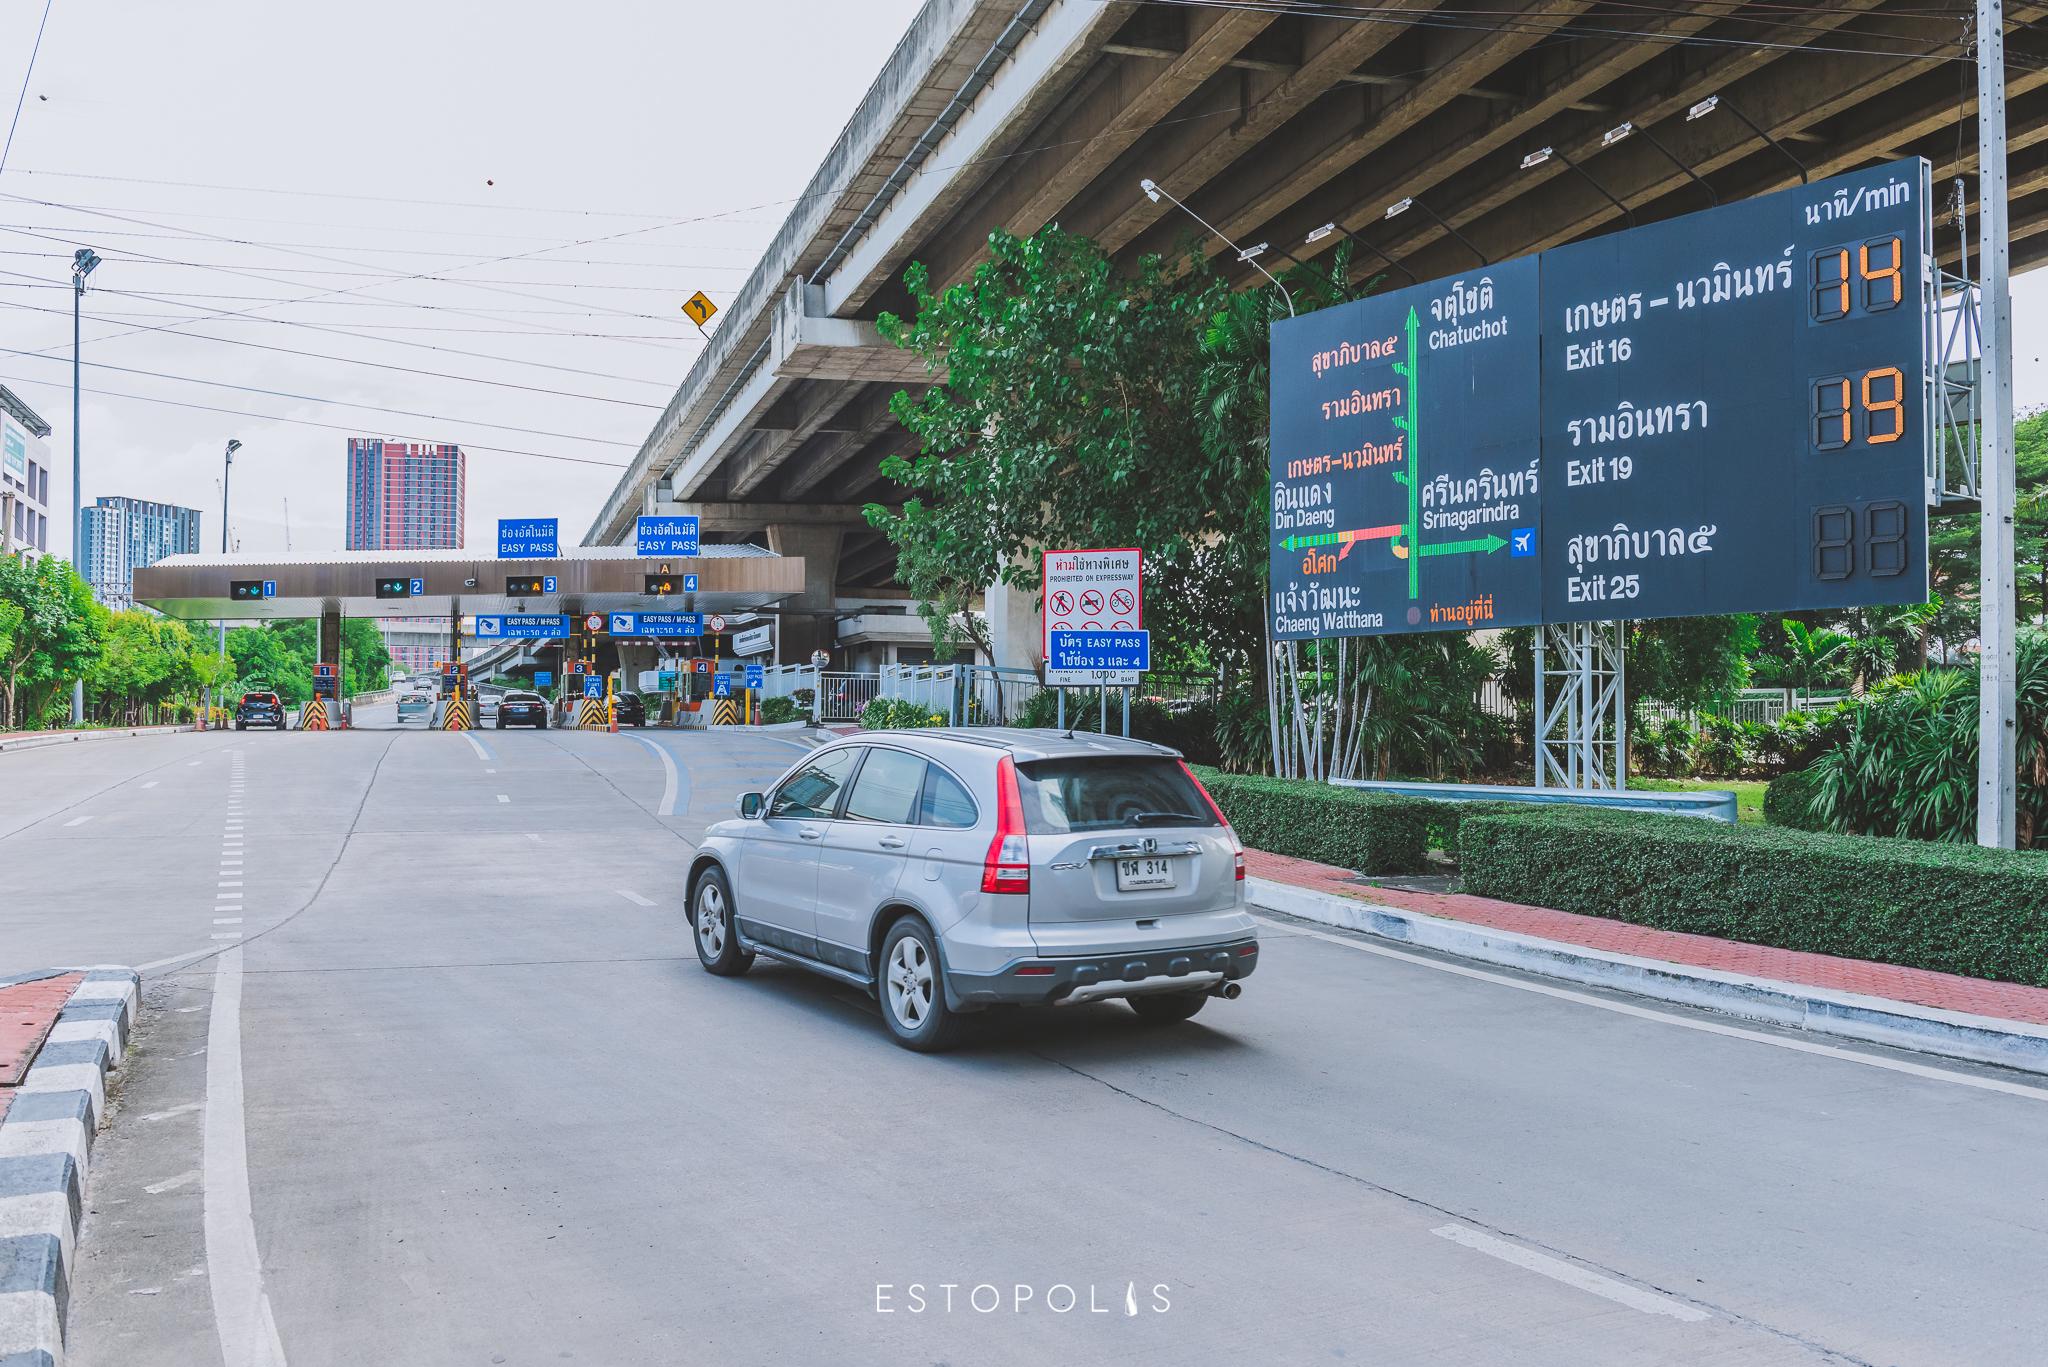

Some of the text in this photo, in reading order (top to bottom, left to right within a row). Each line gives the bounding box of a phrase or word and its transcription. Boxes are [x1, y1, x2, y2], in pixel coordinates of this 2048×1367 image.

[1840, 237, 1902, 314] 14
[1565, 292, 1643, 334] เกษตร
[1676, 244, 1796, 311] นวมินทร์
[1428, 315, 1508, 351] Chatuchot
[1311, 335, 1399, 379] สุขาภิบาล๕
[1566, 337, 1632, 371] Exit 16
[1321, 387, 1401, 421] รามอินทรา
[1842, 366, 1904, 445] 19
[1567, 400, 1709, 447] รามอินทรา
[1422, 458, 1540, 508] ศรีนครินทร์
[1567, 455, 1633, 487] Exit 19
[1274, 481, 1332, 512] ดินแดง
[640, 522, 696, 536] ช่องอัตโนมัติ
[1275, 507, 1335, 530] Din Daeng
[1423, 502, 1519, 531] Srinagarindra
[501, 524, 555, 538] ช่องอัตโนมัติ
[501, 543, 554, 553] EASY PASS
[638, 541, 697, 550] EASY PASS
[1568, 522, 1717, 574] สุขาภิบาล๕
[661, 564, 670, 574] A
[1302, 548, 1338, 576] อโศก
[412, 581, 421, 593] 2
[532, 582, 540, 591] A
[546, 578, 555, 591] 3
[686, 577, 696, 589] 4
[1049, 573, 1135, 583] PROHIBITED ON EXPRESSWAY
[1568, 573, 1640, 603] Exit 25
[1275, 581, 1361, 615] แจ้งวัฒนะ
[1430, 593, 1495, 627] ท่านอยู่ที่นี่
[507, 617, 520, 626] EASY
[521, 617, 536, 626] PASS
[1275, 610, 1383, 636] Chaeng Watthana
[1059, 633, 1141, 648] บัตร EASY PASS
[576, 664, 583, 673] 3
[698, 663, 706, 672] 4
[1059, 650, 1140, 667] ใช้ช่อง 3 และ 4
[1146, 859, 1168, 875] 314
